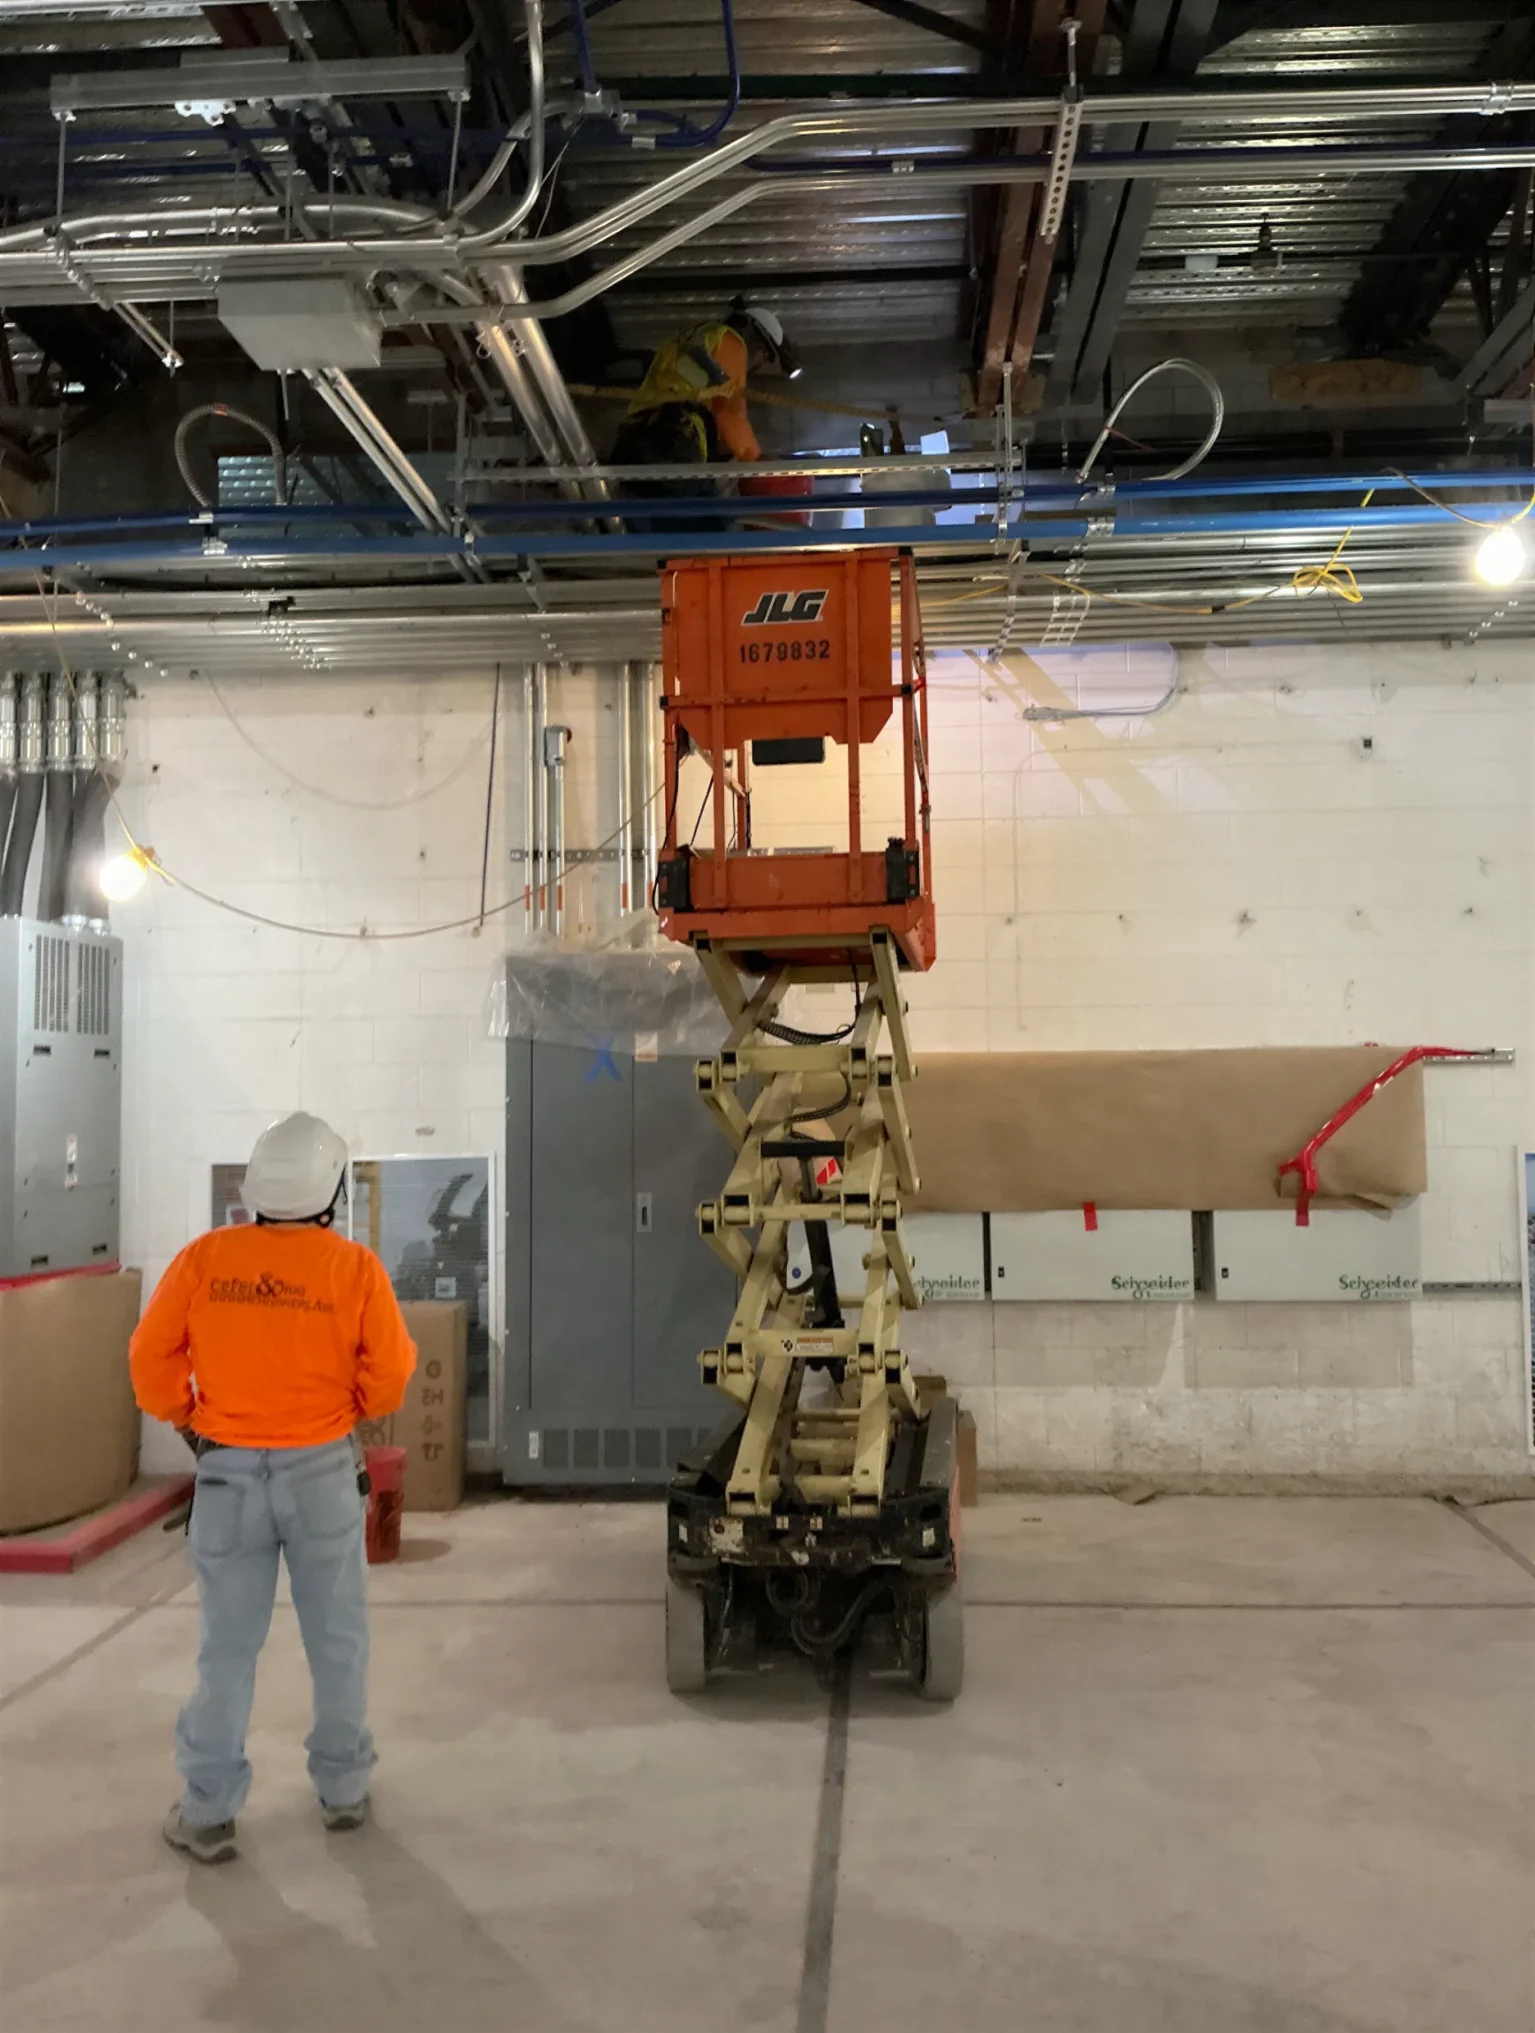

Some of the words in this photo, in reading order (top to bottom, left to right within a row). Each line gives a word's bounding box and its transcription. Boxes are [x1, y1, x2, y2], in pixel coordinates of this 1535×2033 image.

[741, 589, 829, 626] JLG
[740, 639, 830, 664] 1679832
[1339, 1273, 1418, 1299] Schneider
